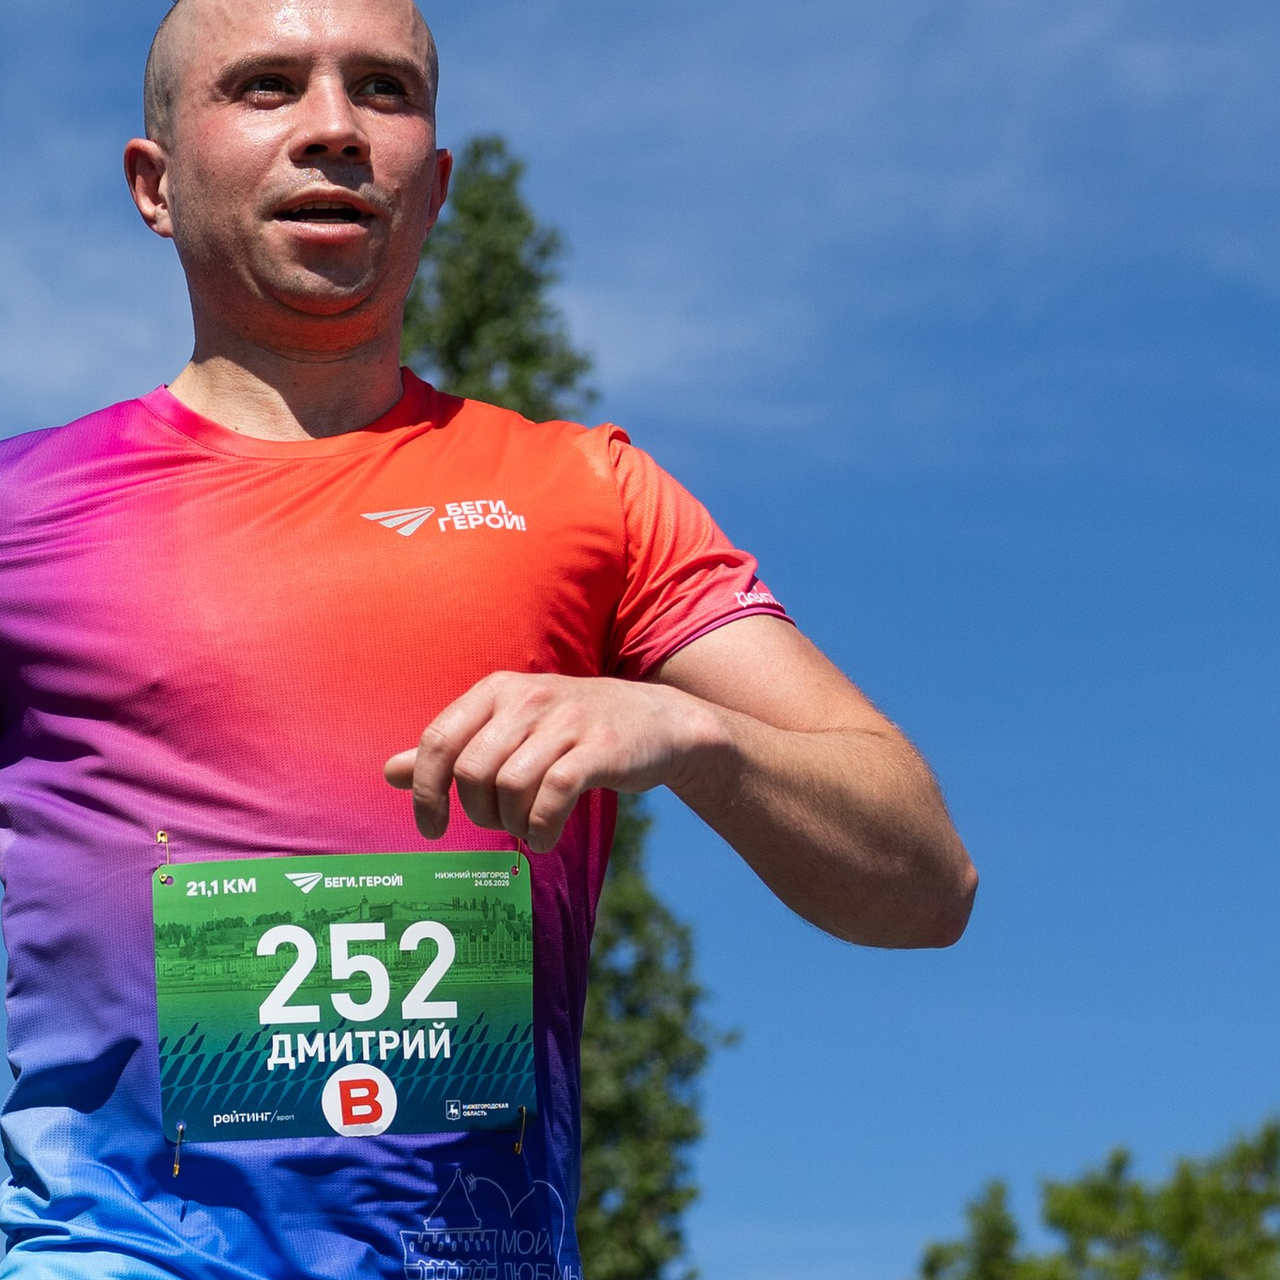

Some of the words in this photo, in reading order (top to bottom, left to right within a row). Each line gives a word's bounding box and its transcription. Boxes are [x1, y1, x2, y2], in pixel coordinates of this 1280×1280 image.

[445, 500, 512, 517] БЕГИ,
[438, 513, 527, 532] ГЕРОЙ!
[435, 870, 470, 879] НИЖНИЙ
[186, 880, 218, 897] 21,1
[223, 878, 257, 894] КМ
[256, 920, 458, 1025] 252
[267, 1022, 451, 1070] ДМИТРИЙ
[501, 1227, 552, 1256] МОЙ
